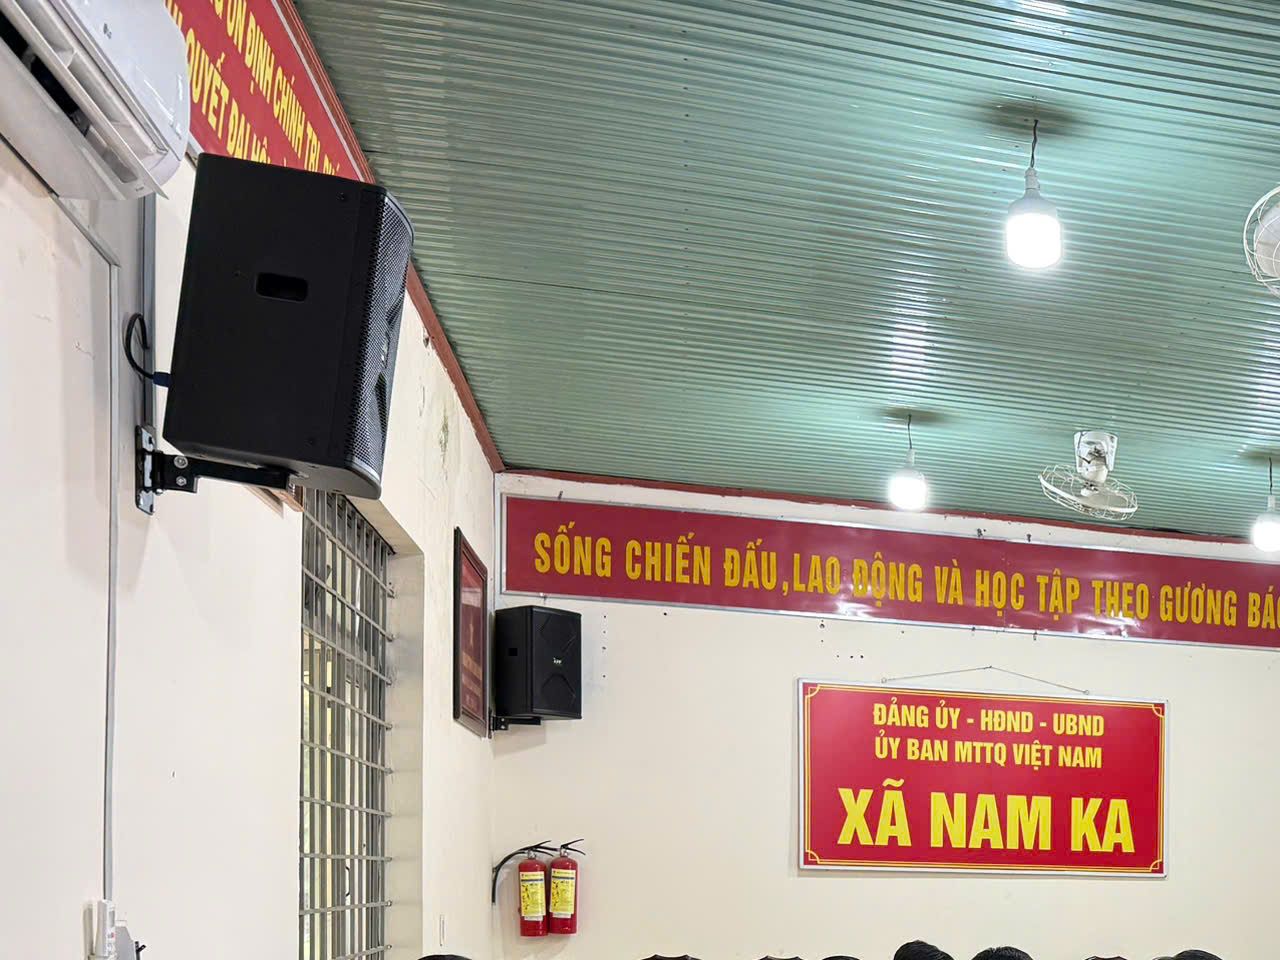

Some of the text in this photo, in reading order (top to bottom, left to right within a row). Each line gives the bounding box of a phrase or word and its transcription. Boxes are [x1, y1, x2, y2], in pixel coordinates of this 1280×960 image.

[245, 11, 275, 104] ĐỊNH
[273, 66, 306, 160] CHÍNH
[533, 521, 612, 578] SỐNG
[625, 531, 711, 585] CHIẾN
[852, 552, 923, 607] ĐỘNG
[935, 558, 964, 605] VÀ
[975, 569, 1025, 617] HỌC
[1036, 568, 1080, 621] TẬP
[1092, 579, 1149, 620] THEO
[1159, 582, 1237, 627] GƯƠNG
[873, 697, 929, 729] ĐẢNG
[935, 700, 961, 730] ỦY
[981, 711, 1033, 733] HĐND
[1053, 713, 1105, 737] UBND
[874, 729, 1102, 770] ỦY BAN MTTQ VIỆT NAM
[837, 778, 1135, 853] XÃ NAM KA
